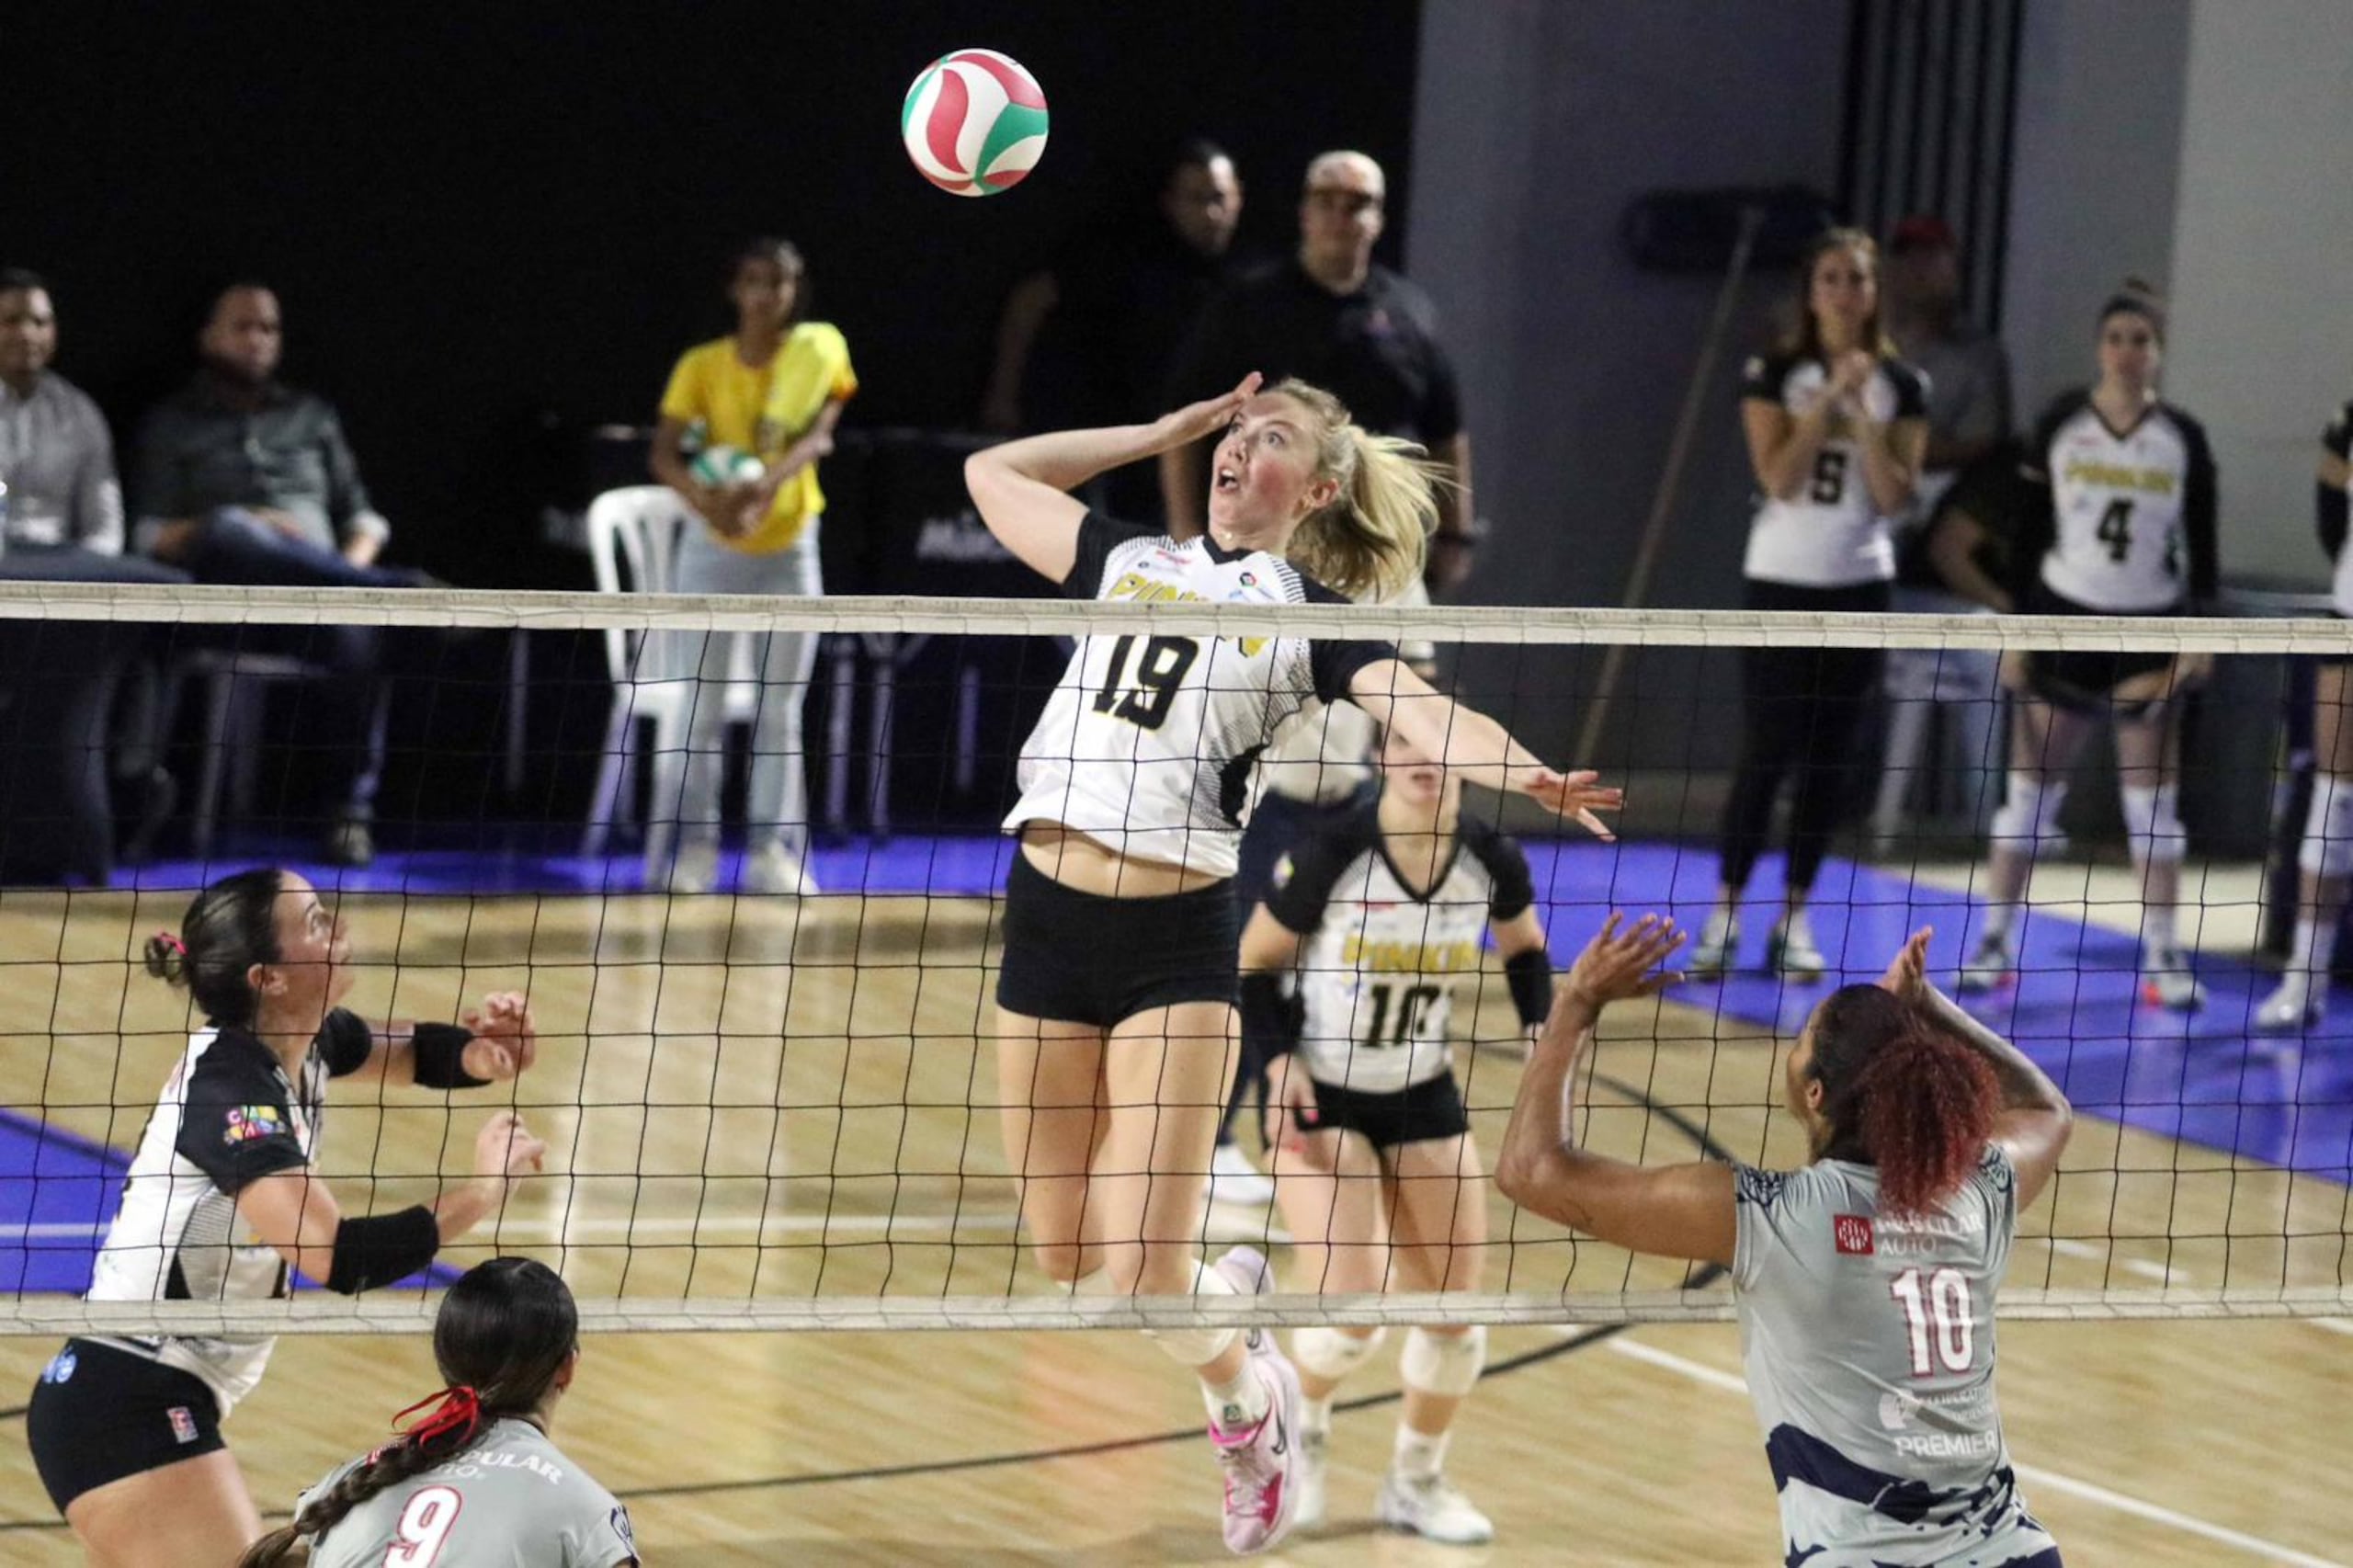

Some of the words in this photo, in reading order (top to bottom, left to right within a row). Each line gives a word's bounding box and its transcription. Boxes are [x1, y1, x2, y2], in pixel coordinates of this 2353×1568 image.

[2097, 498, 2135, 562] 4
[1092, 634, 1199, 732] 19
[1881, 1235, 1937, 1257] AUTO
[1890, 1266, 1975, 1379] 10
[1893, 1430, 1996, 1457] PREMIER
[381, 1484, 463, 1568] 9
